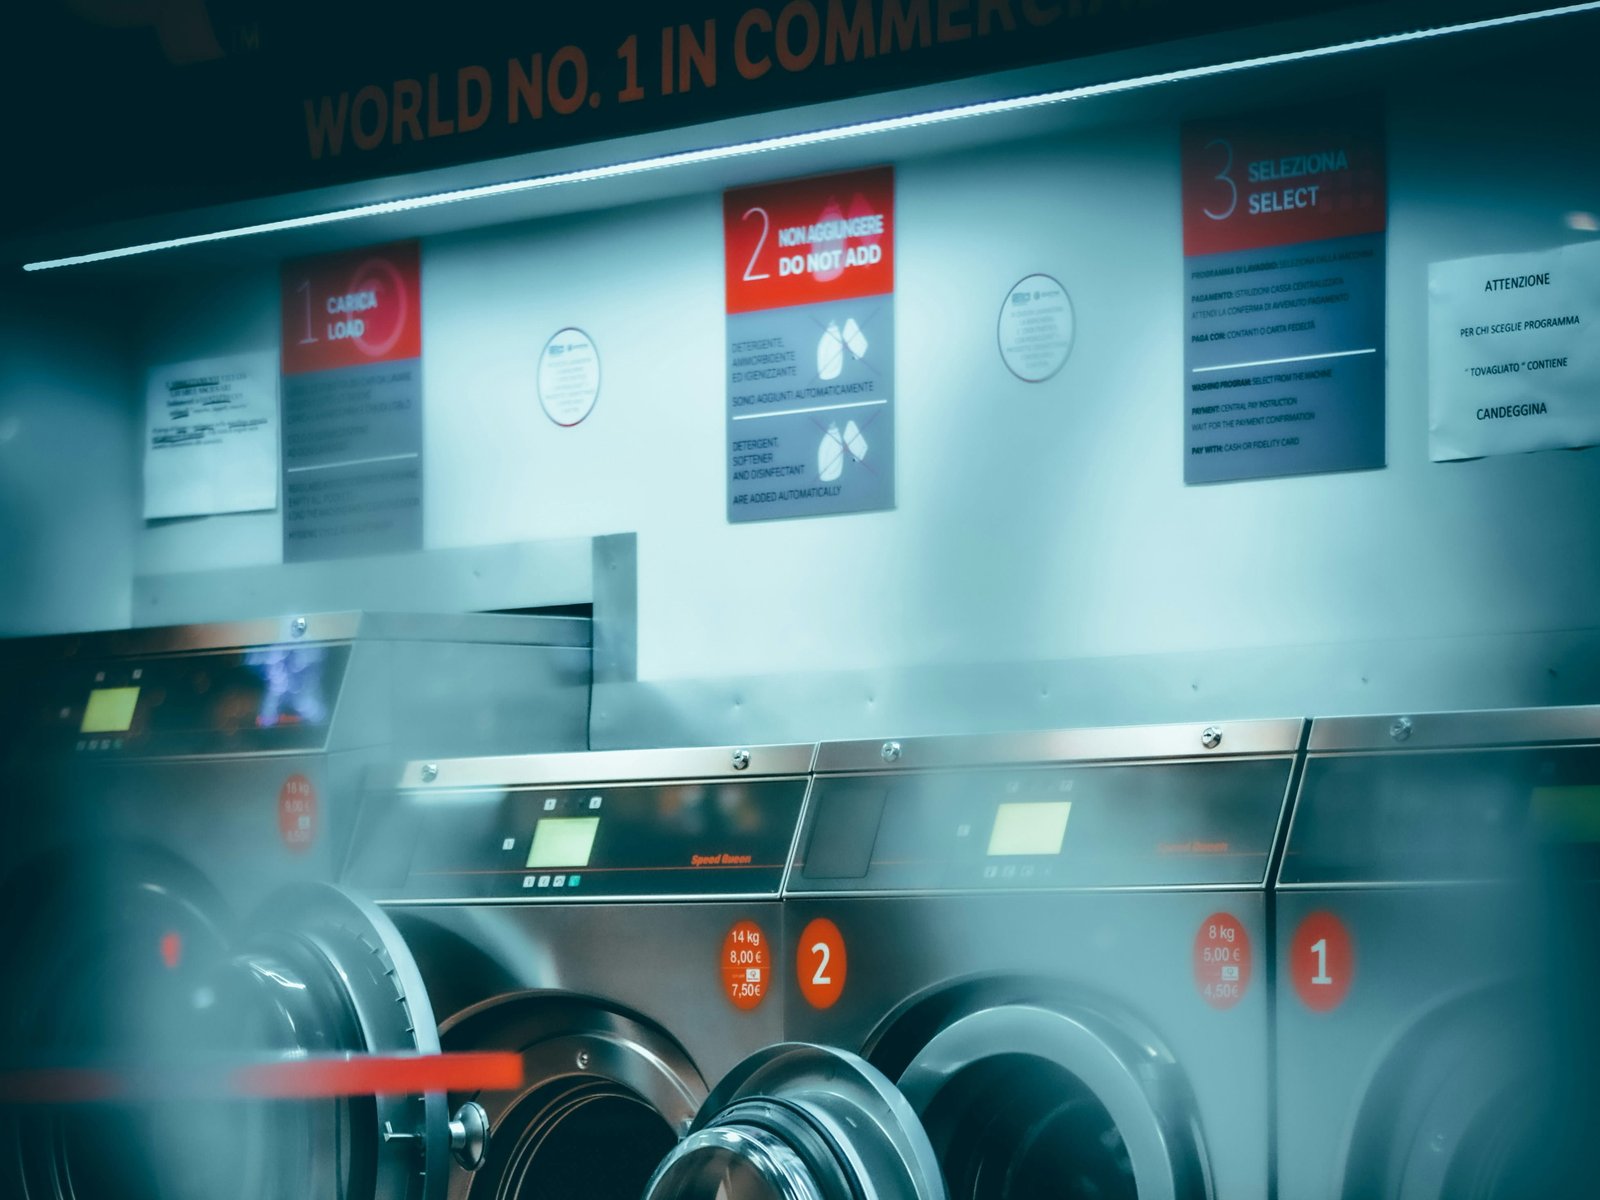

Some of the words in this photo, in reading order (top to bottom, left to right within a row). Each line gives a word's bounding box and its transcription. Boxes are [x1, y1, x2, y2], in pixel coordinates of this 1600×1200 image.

[303, 65, 491, 161] WORLD
[508, 45, 600, 124] NO.
[616, 33, 645, 103] 1
[661, 18, 716, 96] IN
[1248, 149, 1348, 183] SELEZIONA
[1203, 138, 1238, 221] 3
[1248, 185, 1320, 215] SELECT
[778, 226, 806, 248] NON
[806, 214, 884, 243] AGGIUNGERE
[742, 207, 771, 282] 2
[779, 255, 804, 277] DO
[807, 250, 842, 272] NOT
[845, 244, 881, 267] ADD
[1484, 272, 1551, 293] ATTENZIONE
[296, 278, 319, 345] 1
[326, 288, 378, 314] CARICA
[327, 319, 365, 341] LOAD
[1459, 327, 1474, 339] PER
[1475, 325, 1489, 337] CHI
[1490, 321, 1522, 335] SCEGLIE
[1523, 315, 1581, 331] PROGRAMMA
[1470, 362, 1520, 377] TOVAGLIATO
[1527, 357, 1568, 371] CONTIENE
[795, 381, 875, 400] AUTOMATICAMENTE
[1259, 396, 1298, 409] INSTRUCTION
[1476, 402, 1547, 421] CANDEGGINA
[1191, 422, 1208, 432] WAIT
[1208, 420, 1221, 430] FOR
[1222, 419, 1234, 429] THE
[1266, 411, 1315, 425] CONFIRMATION
[1224, 441, 1242, 452] CASH
[1281, 436, 1300, 447] CARD
[732, 453, 774, 467] SOFTENER
[733, 469, 747, 482] AND
[748, 464, 805, 480] DISINFECTANT
[732, 494, 748, 505] ARE
[750, 491, 777, 504] ADDED
[779, 484, 842, 501] AUTOMATICALLY
[731, 931, 744, 944] 14
[747, 930, 760, 947] kg
[1209, 925, 1216, 939] 8
[1220, 926, 1235, 942] kg
[729, 949, 753, 966] 8,00
[755, 951, 762, 964] €
[810, 941, 832, 985] 2
[1203, 947, 1229, 964] 5,00
[1233, 948, 1240, 961] €
[1310, 938, 1333, 985] 1
[731, 983, 761, 999] 7,50€
[1203, 984, 1239, 999] 4,50€
